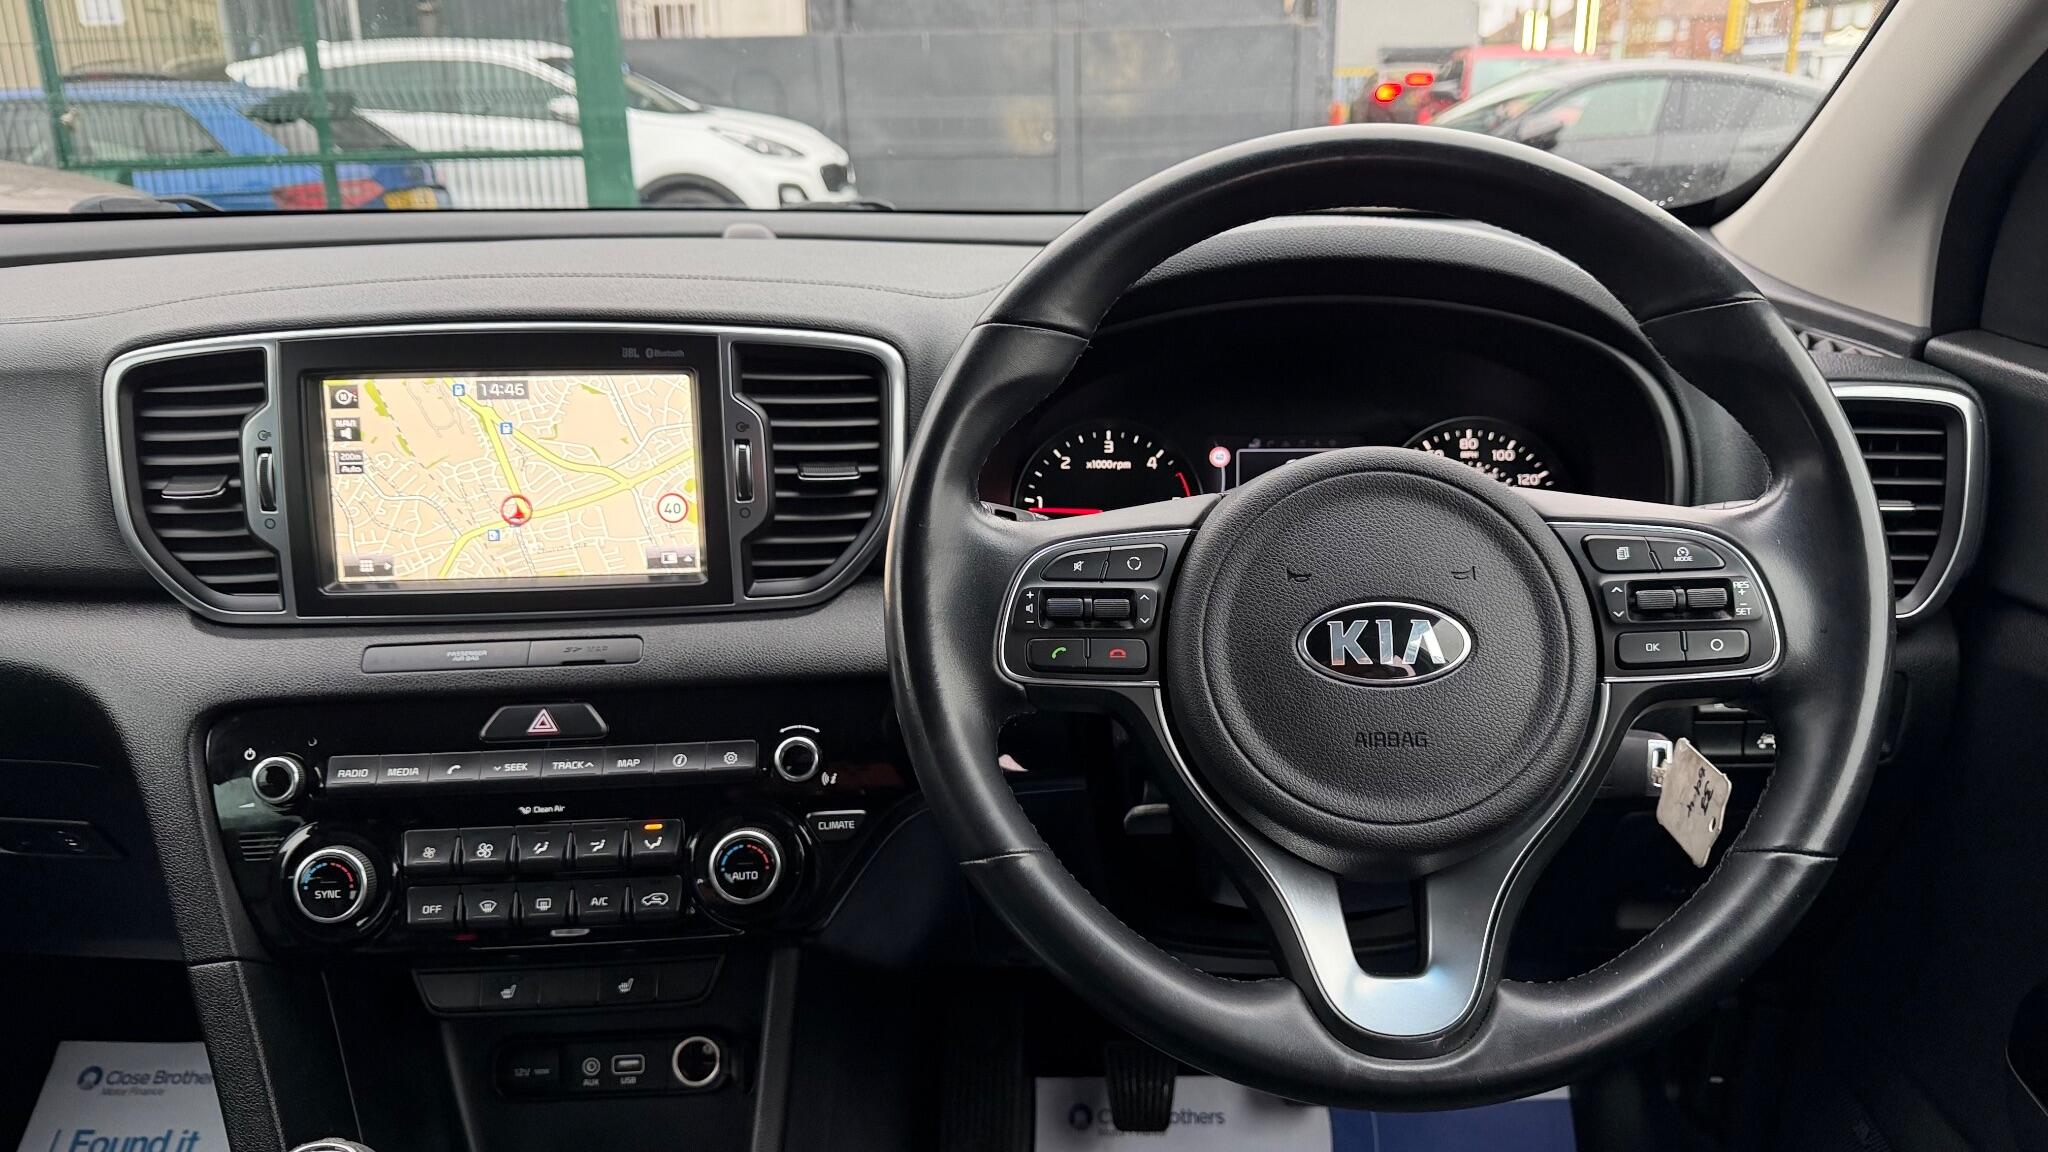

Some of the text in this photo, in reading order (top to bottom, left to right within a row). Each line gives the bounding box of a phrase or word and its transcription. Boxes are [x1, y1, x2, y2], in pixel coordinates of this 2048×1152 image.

[481, 383, 525, 396] 14:46
[1103, 440, 1114, 454] 3
[1459, 437, 1480, 450] 80
[340, 452, 362, 460] 200m
[1491, 449, 1516, 462] 100
[1060, 456, 1071, 470] 2
[1085, 459, 1132, 471] x1000rpm
[1146, 456, 1158, 470] 4
[1517, 473, 1541, 486] 120
[664, 503, 681, 514] 40
[1733, 581, 1750, 589] RES
[1735, 608, 1752, 616] SET
[1327, 619, 1446, 666] KIA
[1646, 643, 1660, 652] OK
[1354, 731, 1428, 748] AIRBAG
[504, 762, 529, 772] SEEK
[552, 760, 585, 770] TRACK
[616, 758, 641, 768] MAP
[337, 768, 369, 778] RADIO
[387, 767, 419, 777] MEDIA
[817, 820, 855, 830] CLIMATE
[732, 870, 759, 880] AUTO
[314, 889, 341, 900] SYNC
[591, 896, 609, 906] A/C
[422, 904, 442, 914] OFF
[106, 1070, 150, 1086] Close
[583, 1079, 599, 1087] AUX
[620, 1077, 637, 1085] USB
[1170, 1108, 1226, 1124] others
[69, 1129, 201, 1152] Found it
